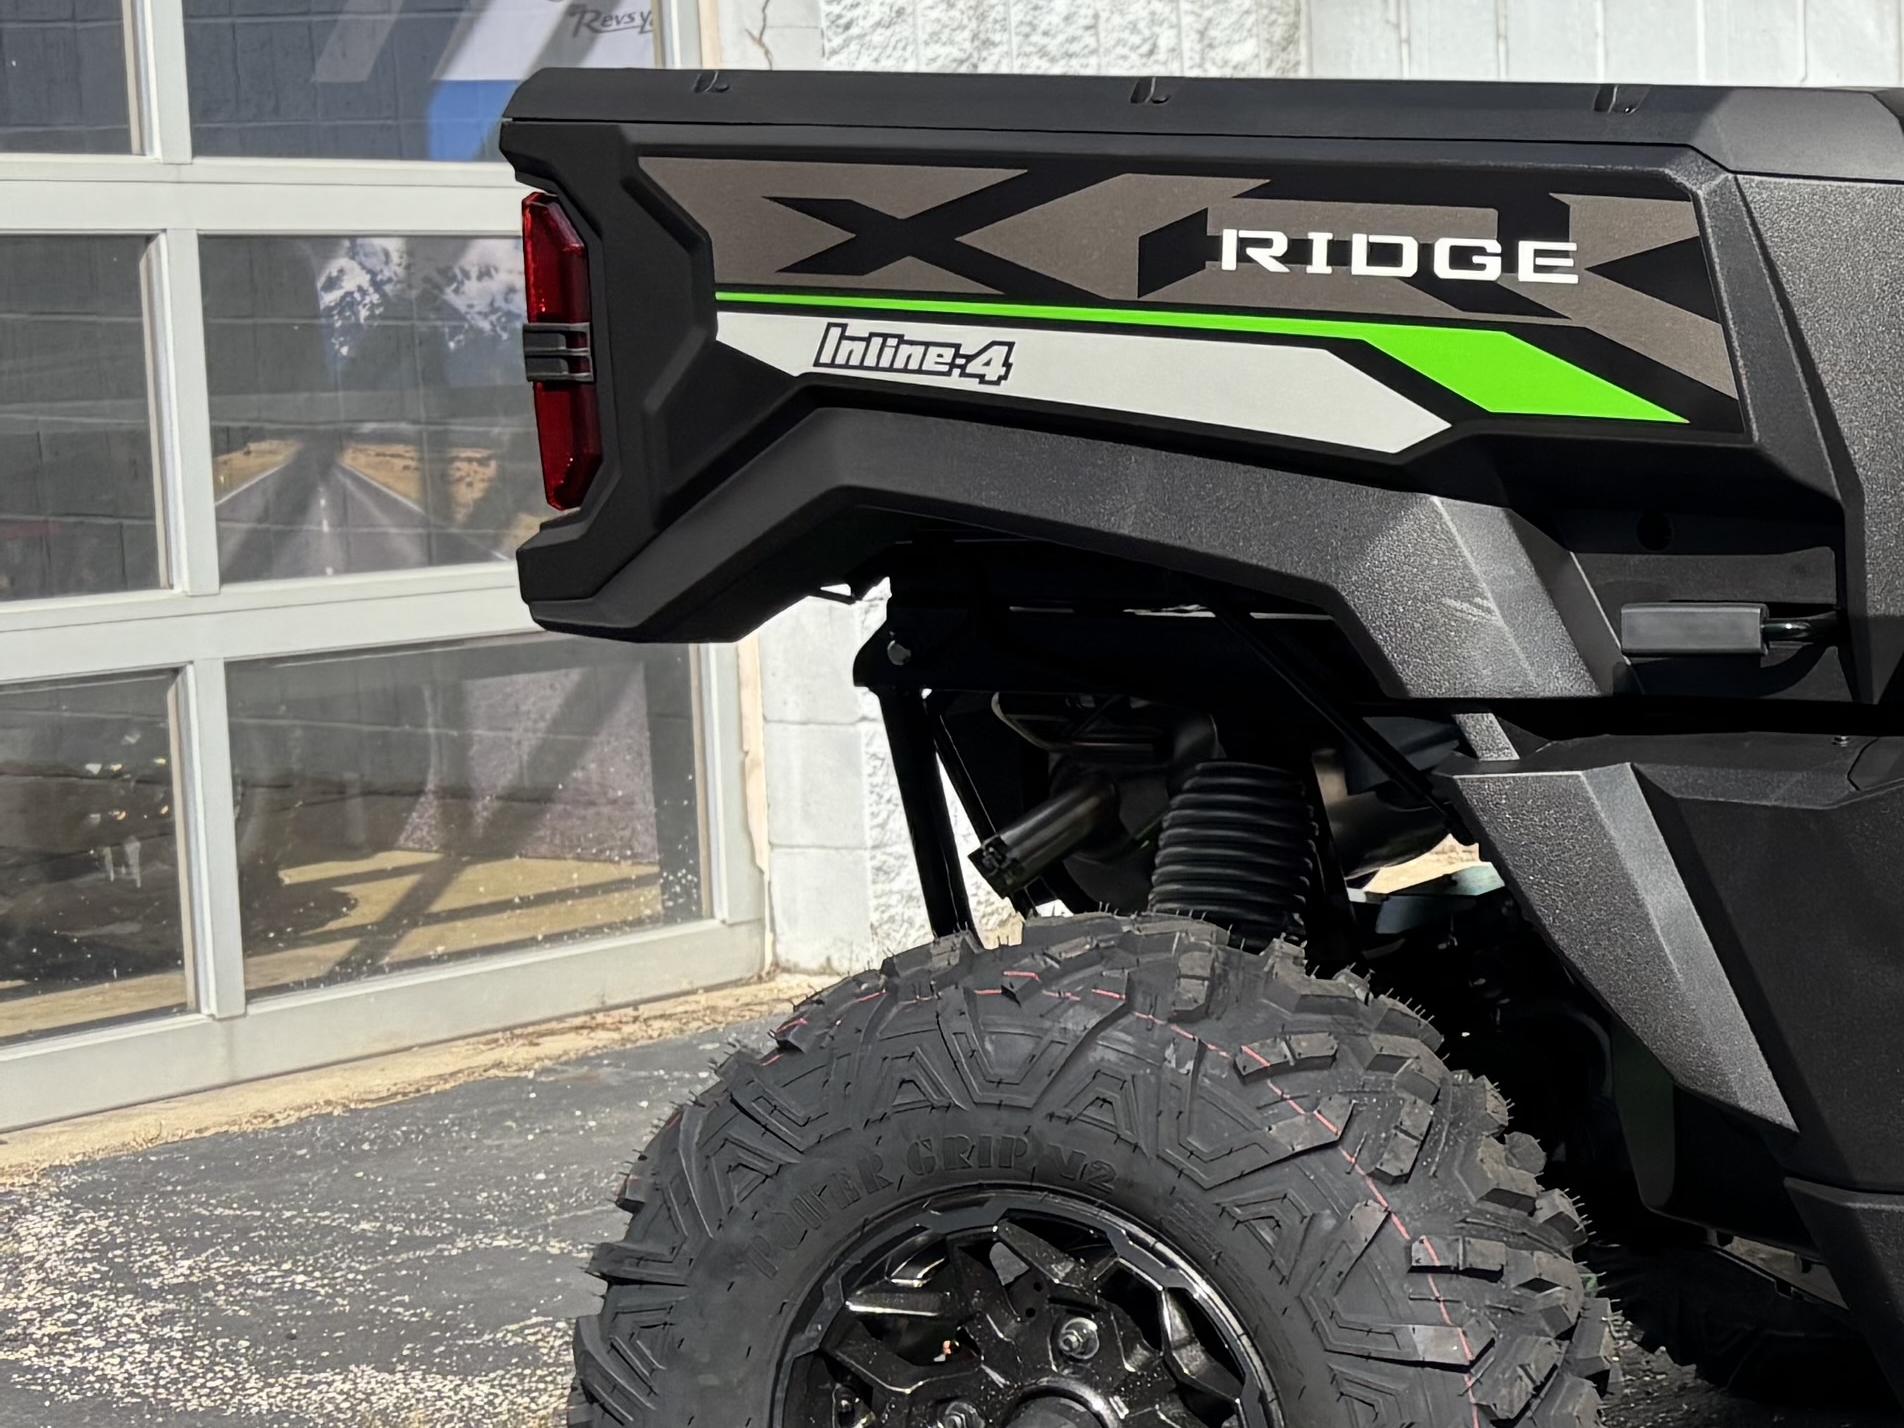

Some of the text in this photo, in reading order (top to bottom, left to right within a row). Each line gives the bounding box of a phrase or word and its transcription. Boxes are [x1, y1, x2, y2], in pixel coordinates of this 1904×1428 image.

[1221, 228, 1579, 284] RIDGE
[813, 322, 1015, 386] Inline-4
[905, 1133, 1031, 1177] GRIP
